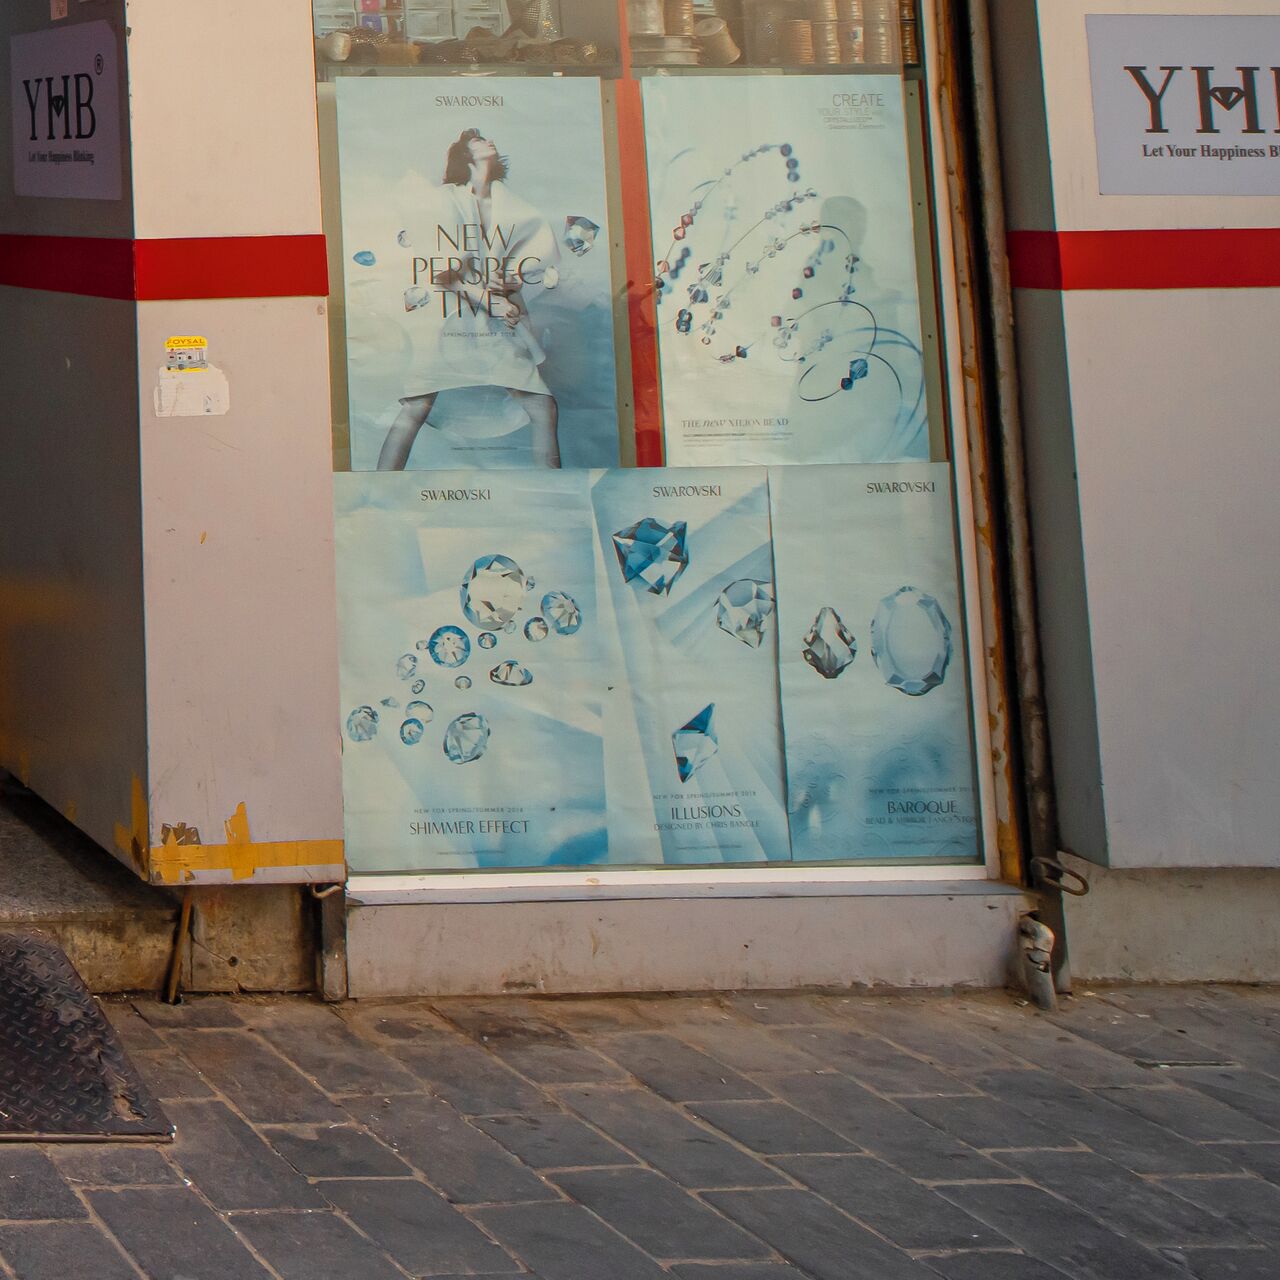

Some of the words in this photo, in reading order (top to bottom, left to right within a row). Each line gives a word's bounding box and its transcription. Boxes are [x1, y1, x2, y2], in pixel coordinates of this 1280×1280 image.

[22, 73, 97, 141] YHB
[435, 95, 505, 108] SWAROVSKI
[832, 93, 886, 107] CREATE
[1142, 144, 1164, 157] Let
[1166, 144, 1197, 157] Your
[1199, 144, 1266, 161] Happiness
[436, 223, 516, 252] NEW
[412, 256, 542, 286] PERSPEC
[420, 489, 491, 501] SWAROVSKI
[652, 485, 722, 499] SWAROVSKI
[866, 481, 936, 495] SWAROVSKI
[671, 804, 741, 820] ILLUSIONS
[887, 800, 958, 814] BAROQUE
[409, 820, 475, 835] SHIMMER
[479, 819, 530, 834] EFFECT
[654, 822, 693, 831] DESIGNED
[695, 822, 703, 830] BY
[705, 820, 728, 829] CHRIS
[729, 820, 760, 829] BANGLE
